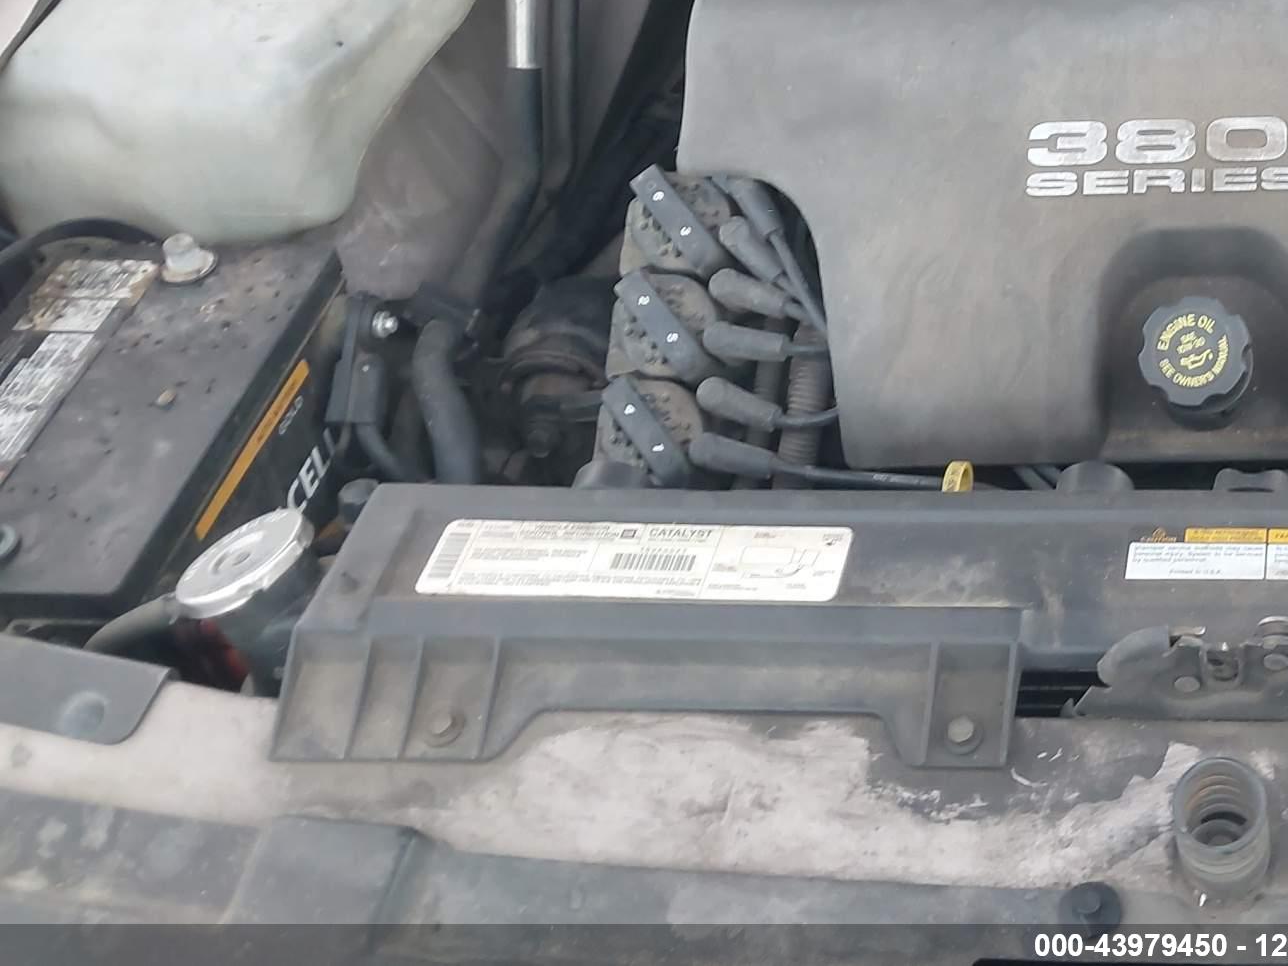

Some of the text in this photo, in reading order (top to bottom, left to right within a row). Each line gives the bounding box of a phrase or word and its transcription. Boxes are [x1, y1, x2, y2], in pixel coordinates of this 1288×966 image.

[1157, 313, 1196, 351] ENGINE
[1197, 314, 1216, 334] OIL
[648, 527, 713, 540] CATALYST
